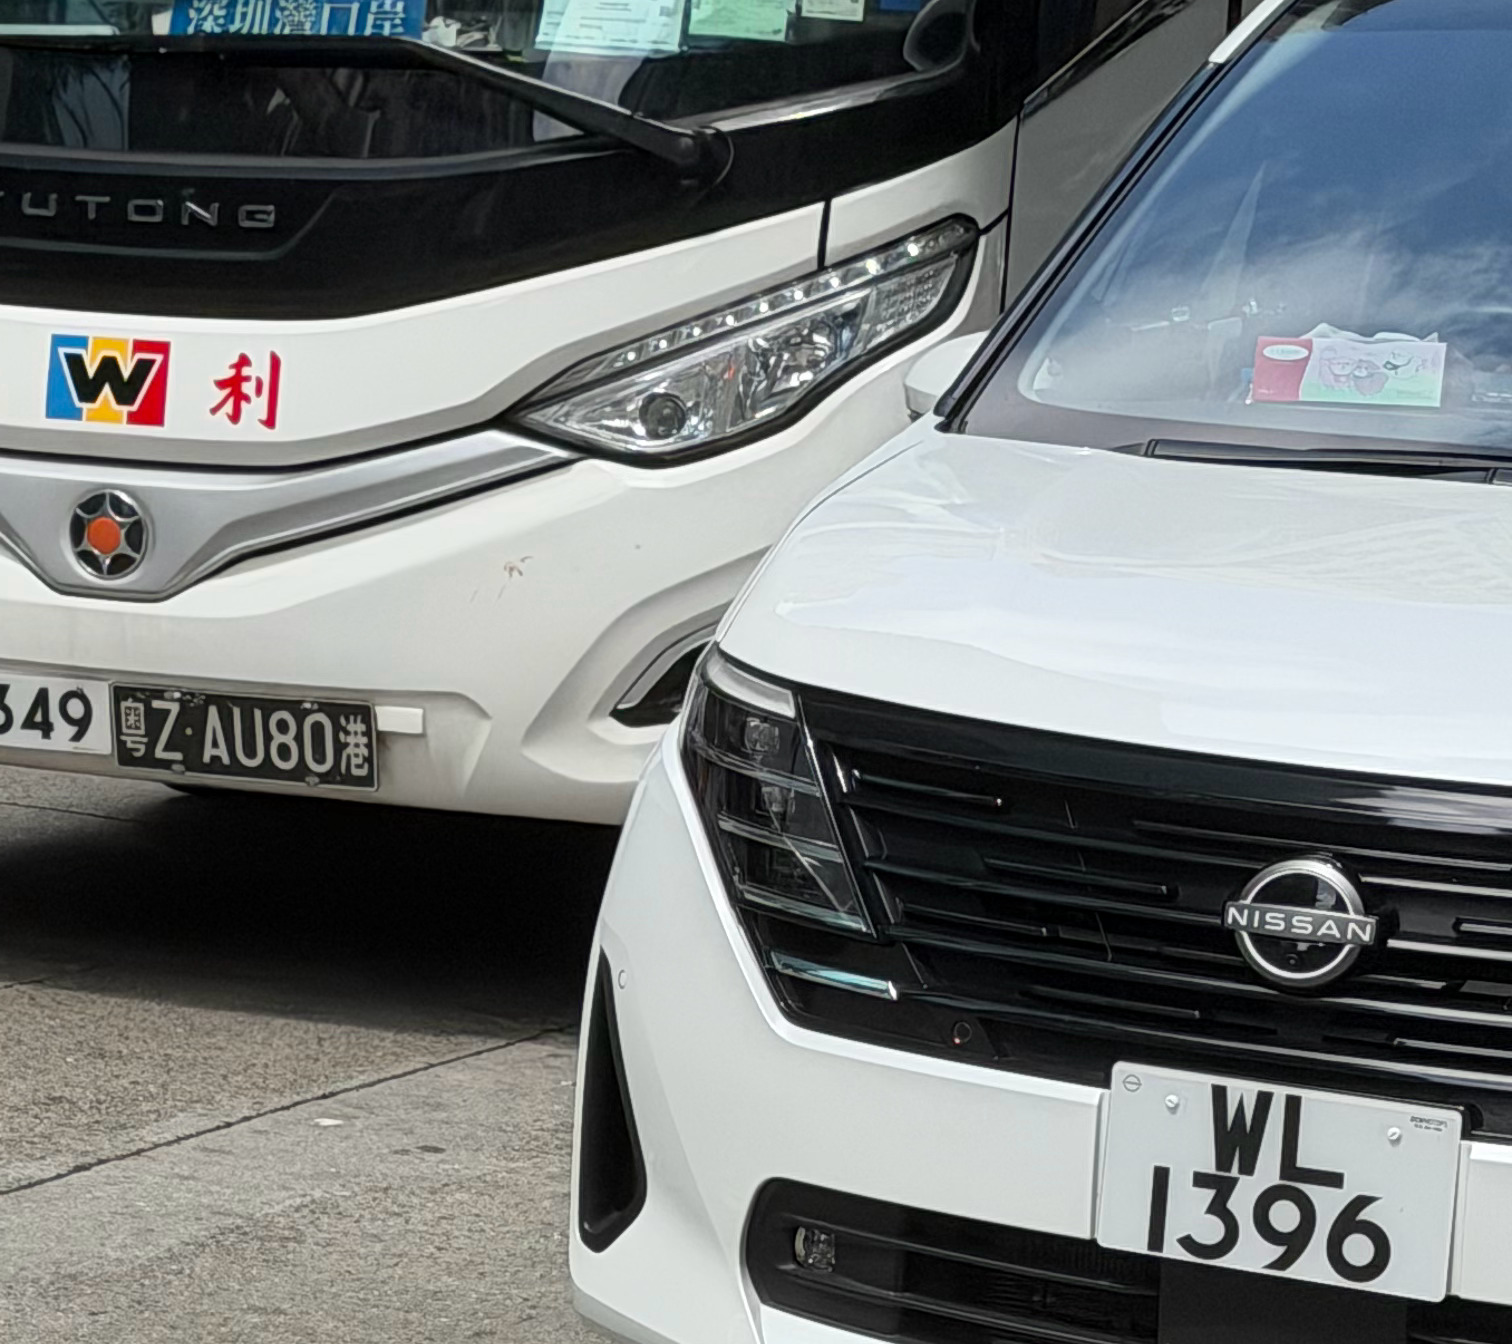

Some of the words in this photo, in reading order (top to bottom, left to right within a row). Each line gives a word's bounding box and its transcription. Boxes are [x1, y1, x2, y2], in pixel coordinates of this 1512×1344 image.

[60, 349, 160, 408] W
[209, 351, 281, 429] 利
[1227, 906, 1372, 942] NISSAN
[1211, 1083, 1344, 1190] WL
[1147, 1165, 1392, 1283] 1396
